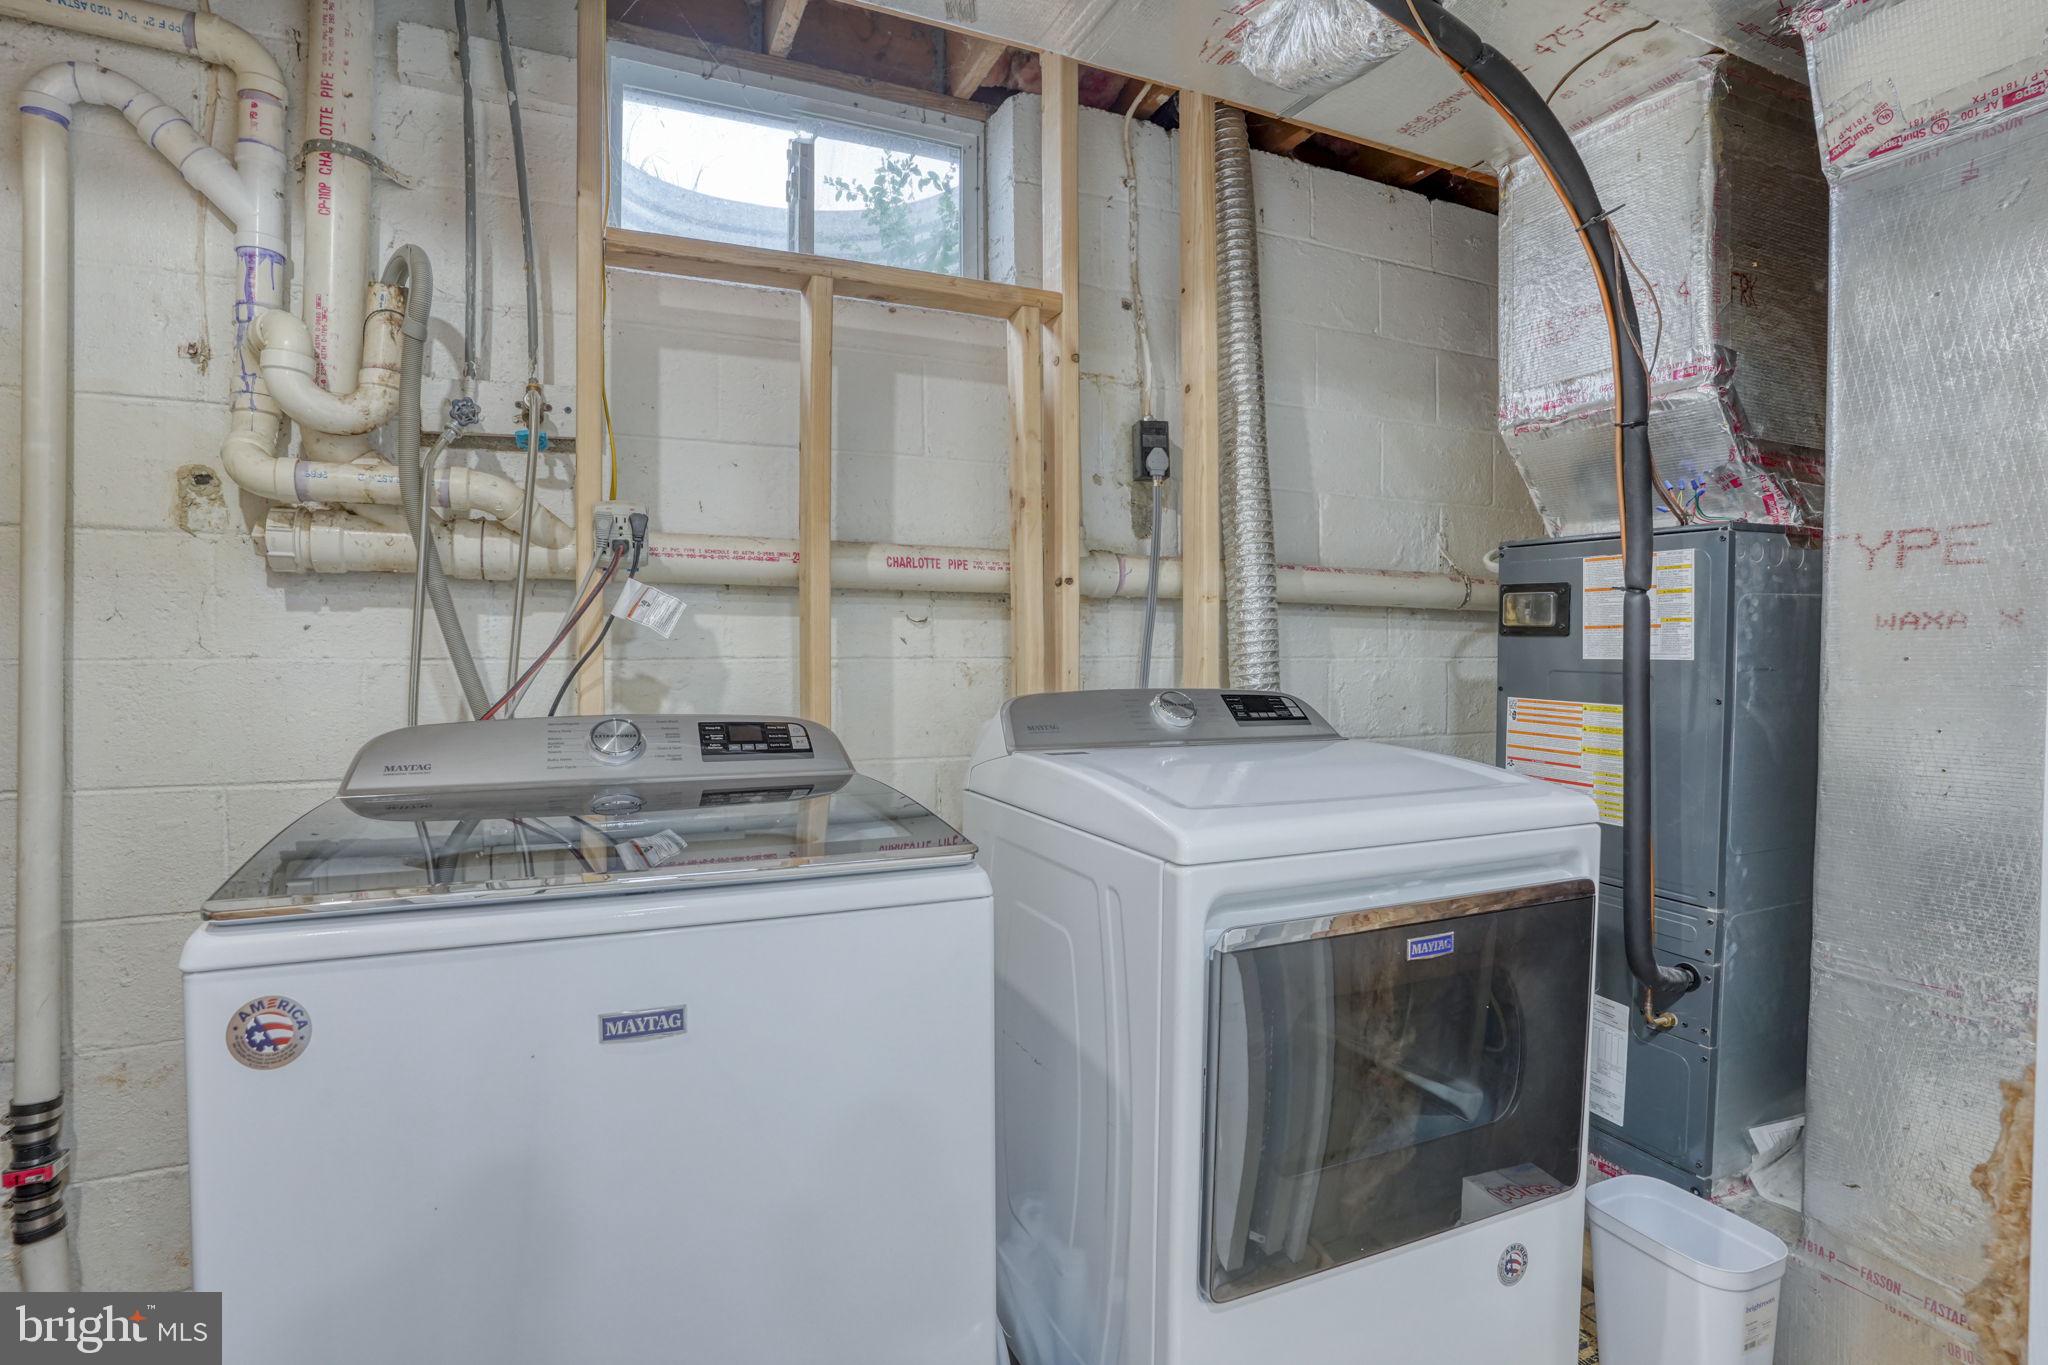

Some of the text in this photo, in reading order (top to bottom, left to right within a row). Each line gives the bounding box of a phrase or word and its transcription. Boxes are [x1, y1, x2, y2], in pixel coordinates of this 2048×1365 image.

[320, 71, 334, 99] PIPE
[1972, 80, 2018, 104] 181B-FX
[1961, 107, 1980, 121] 100
[1984, 99, 1999, 113] AF
[318, 106, 333, 176] CHAOTTE
[886, 555, 969, 571] CHARLOTTE PIPE
[383, 763, 432, 773] MAYTAG
[1407, 938, 1452, 955] MAYTAG
[238, 998, 309, 1031] AMERICA
[604, 1013, 682, 1036] MAYTAG
[1859, 1266, 1903, 1297] FASSON
[1923, 1296, 1972, 1331] FASTAP
